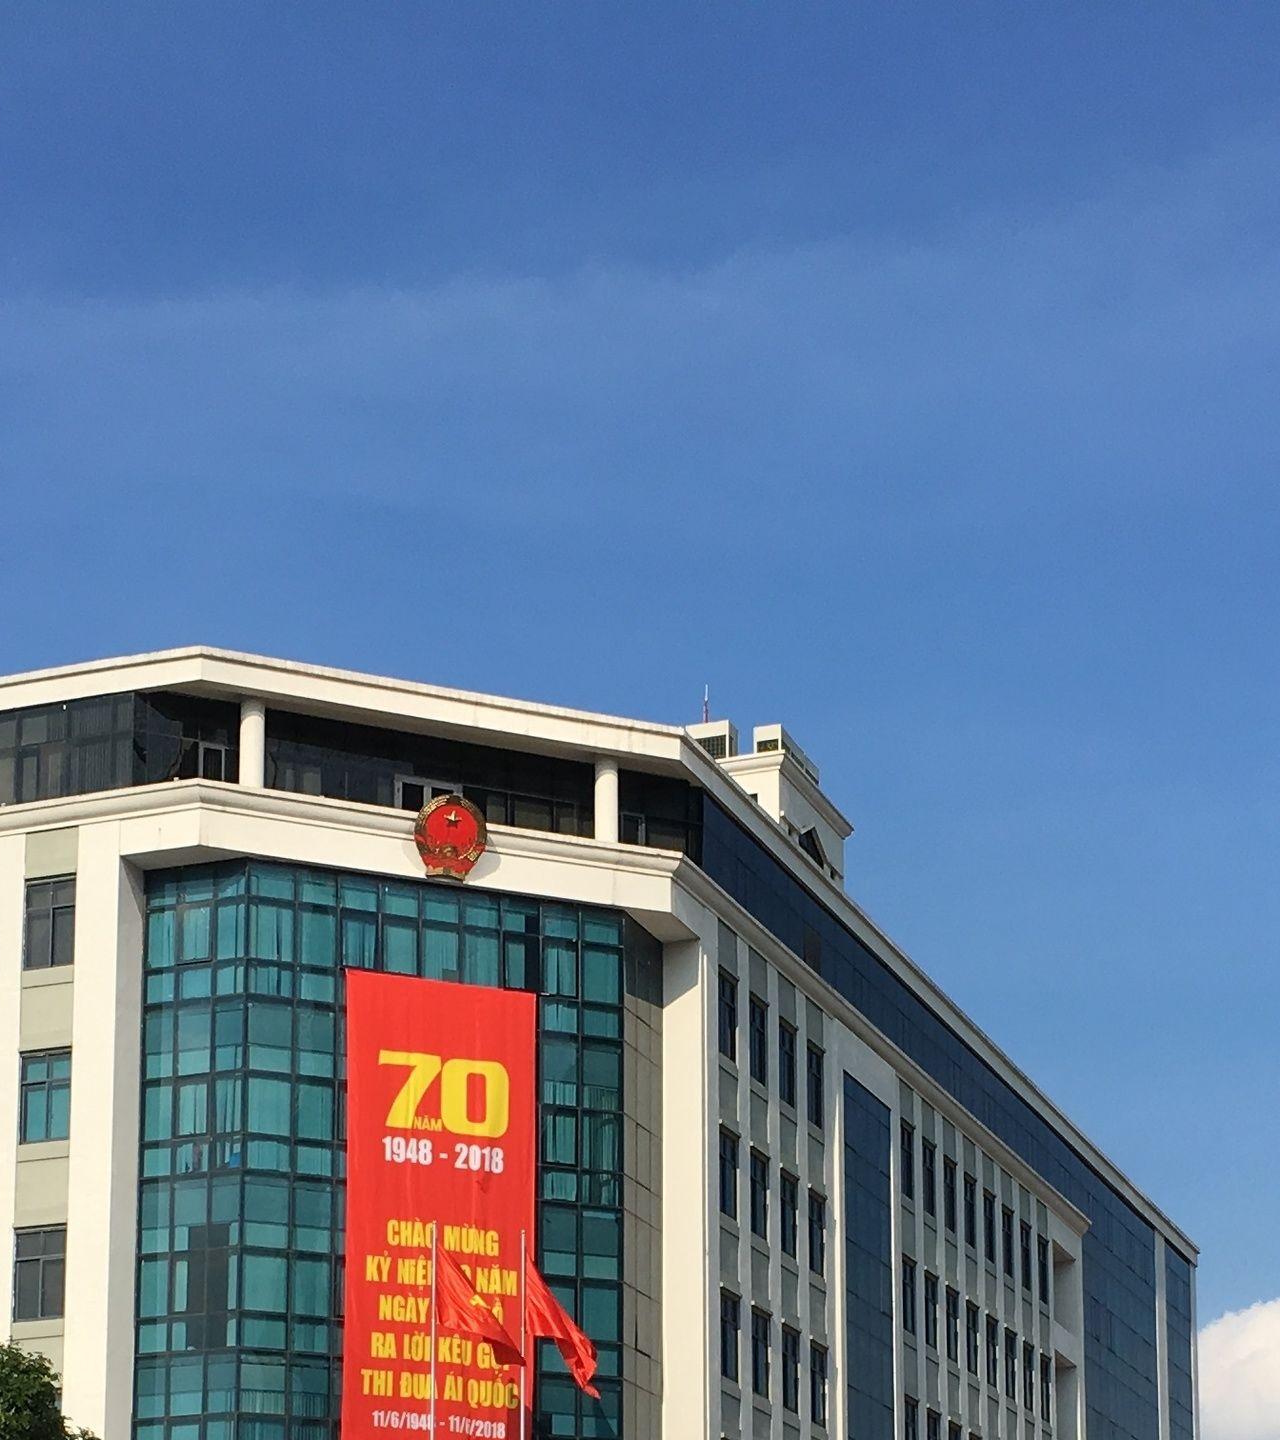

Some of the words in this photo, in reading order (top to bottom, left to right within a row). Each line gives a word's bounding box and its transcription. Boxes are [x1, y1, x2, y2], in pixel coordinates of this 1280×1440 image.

[378, 1049, 510, 1138] 70
[413, 1115, 443, 1132] NĂM
[382, 1136, 433, 1165] 1948
[454, 1143, 505, 1174] 2018
[443, 1222, 500, 1257] MỪNG
[365, 1250, 392, 1282] KỶ
[475, 1263, 518, 1297] NĂM
[378, 1292, 431, 1324] NGÀY
[370, 1331, 397, 1360] RA
[403, 1330, 432, 1362] LỜI
[437, 1333, 473, 1366] KÊU
[360, 1368, 395, 1397] THI
[399, 1371, 439, 1399] ĐUA
[443, 1371, 464, 1402] ÁI
[467, 1372, 520, 1409] QUỐC
